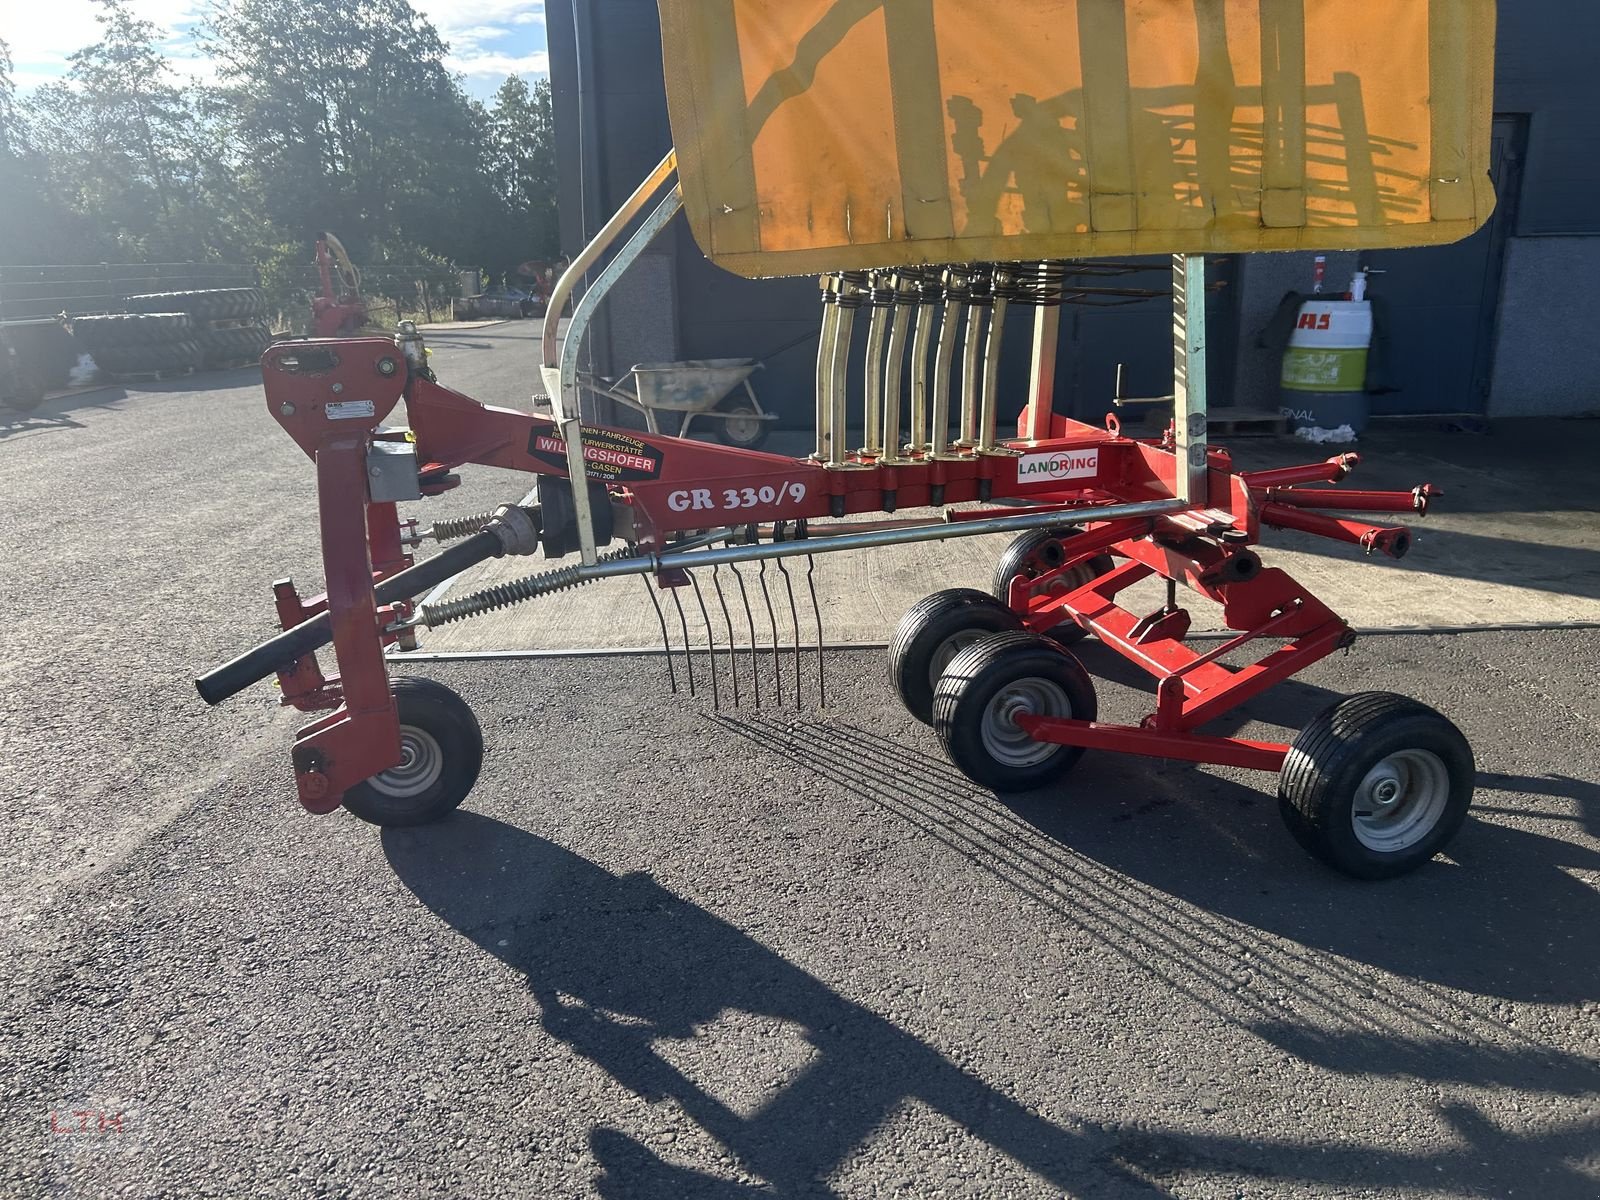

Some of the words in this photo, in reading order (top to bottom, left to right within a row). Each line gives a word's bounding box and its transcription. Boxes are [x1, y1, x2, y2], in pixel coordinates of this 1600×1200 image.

[1019, 456, 1097, 475] LANDRING
[667, 488, 715, 512] GR
[722, 480, 806, 509] 330/9
